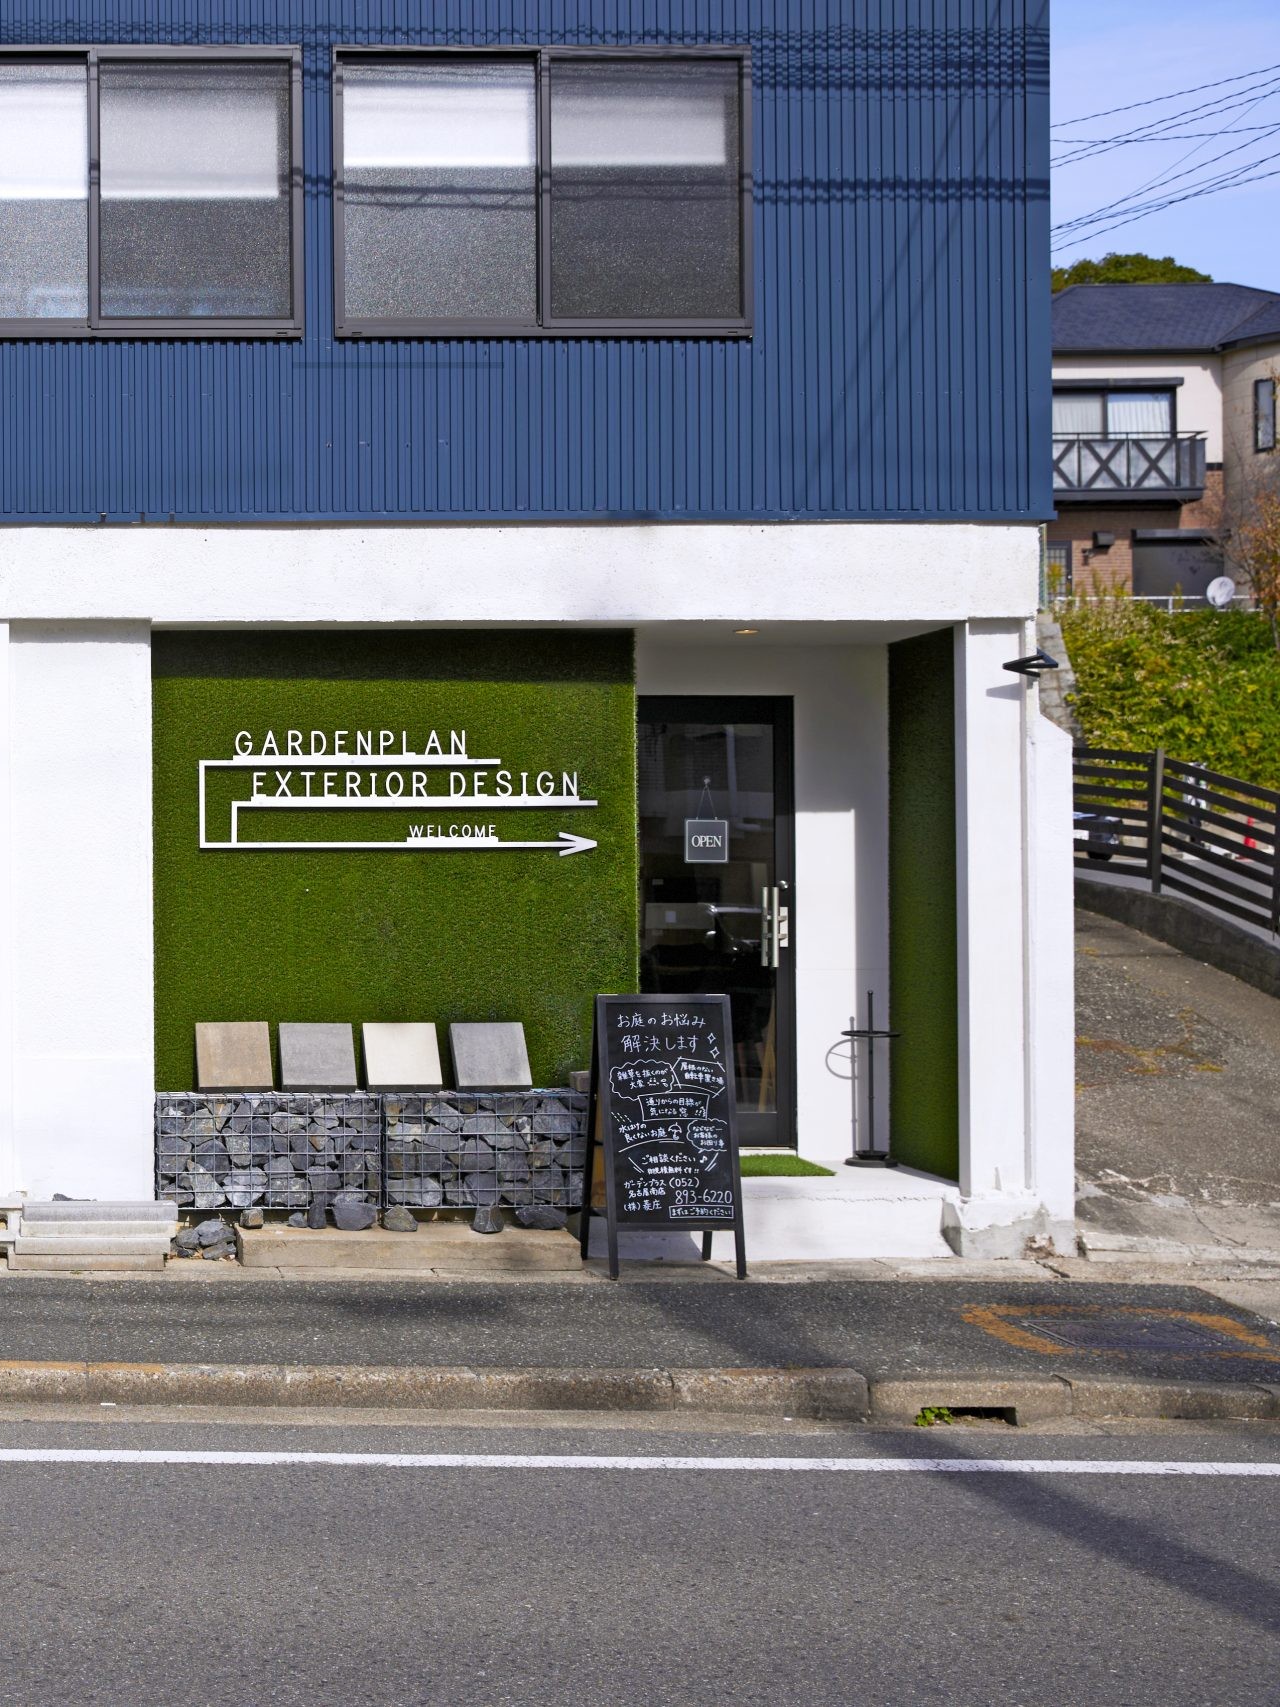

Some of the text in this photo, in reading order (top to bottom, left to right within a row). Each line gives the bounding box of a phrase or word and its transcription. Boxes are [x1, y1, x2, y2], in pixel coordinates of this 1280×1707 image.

[235, 730, 467, 756] GARDENPLAN
[252, 771, 579, 797] EXTERIOR DESIGN
[409, 824, 497, 838] WELCOME
[691, 834, 723, 848] OPEN
[617, 1012, 706, 1028] お庭のお悩み
[621, 1034, 699, 1053] 解決します
[669, 1177, 700, 1189] (052)
[675, 1189, 732, 1204] 893-6220
